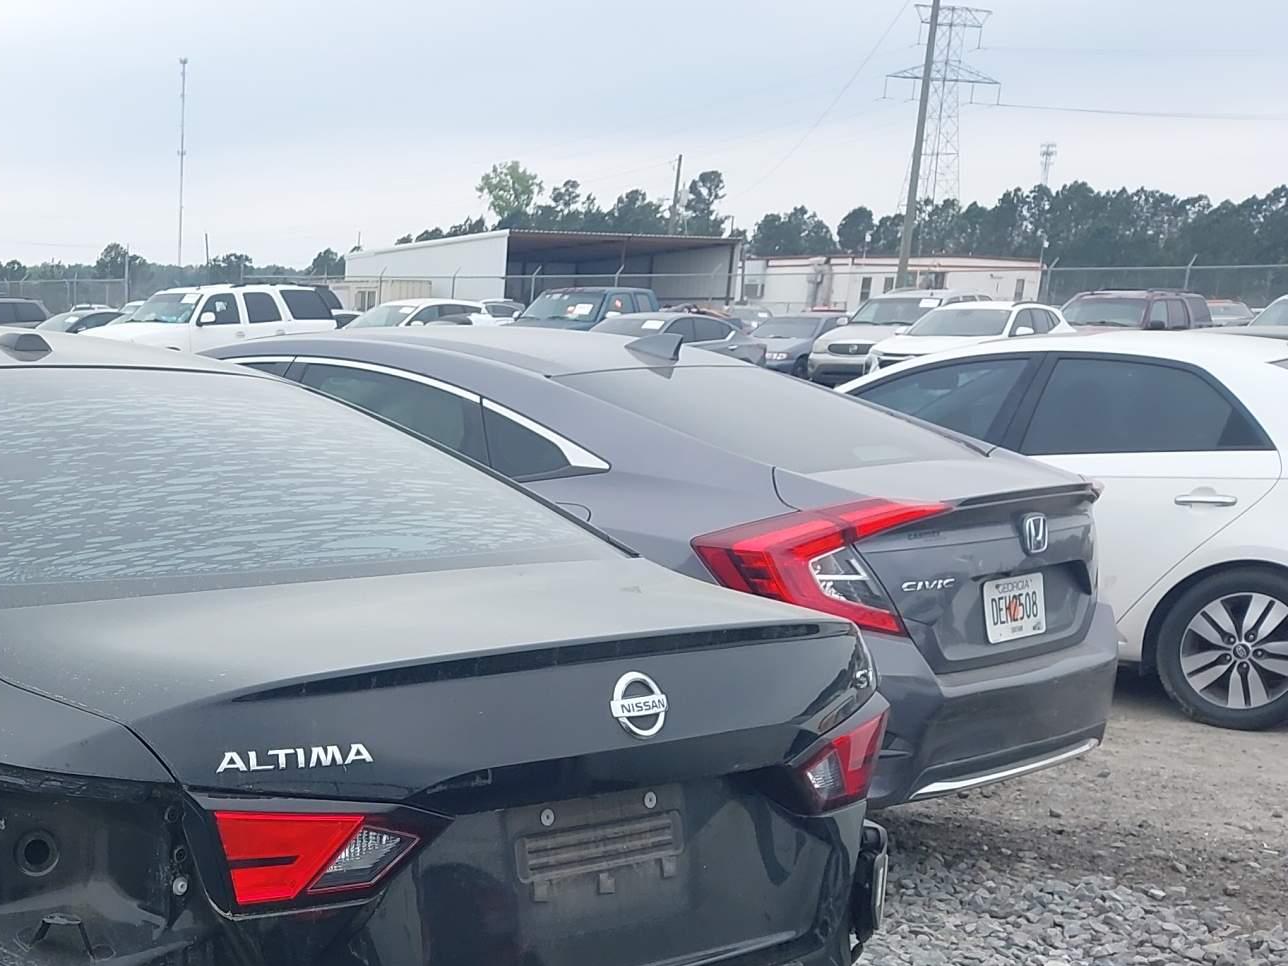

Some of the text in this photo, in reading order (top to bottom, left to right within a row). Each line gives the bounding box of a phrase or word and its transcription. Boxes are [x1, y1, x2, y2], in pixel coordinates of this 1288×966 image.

[901, 578, 956, 592] CIVIC
[998, 579, 1031, 594] GEORGIA
[990, 590, 1039, 627] DEH2508
[621, 698, 666, 714] NISSAN
[215, 743, 374, 775] ALTIMA
